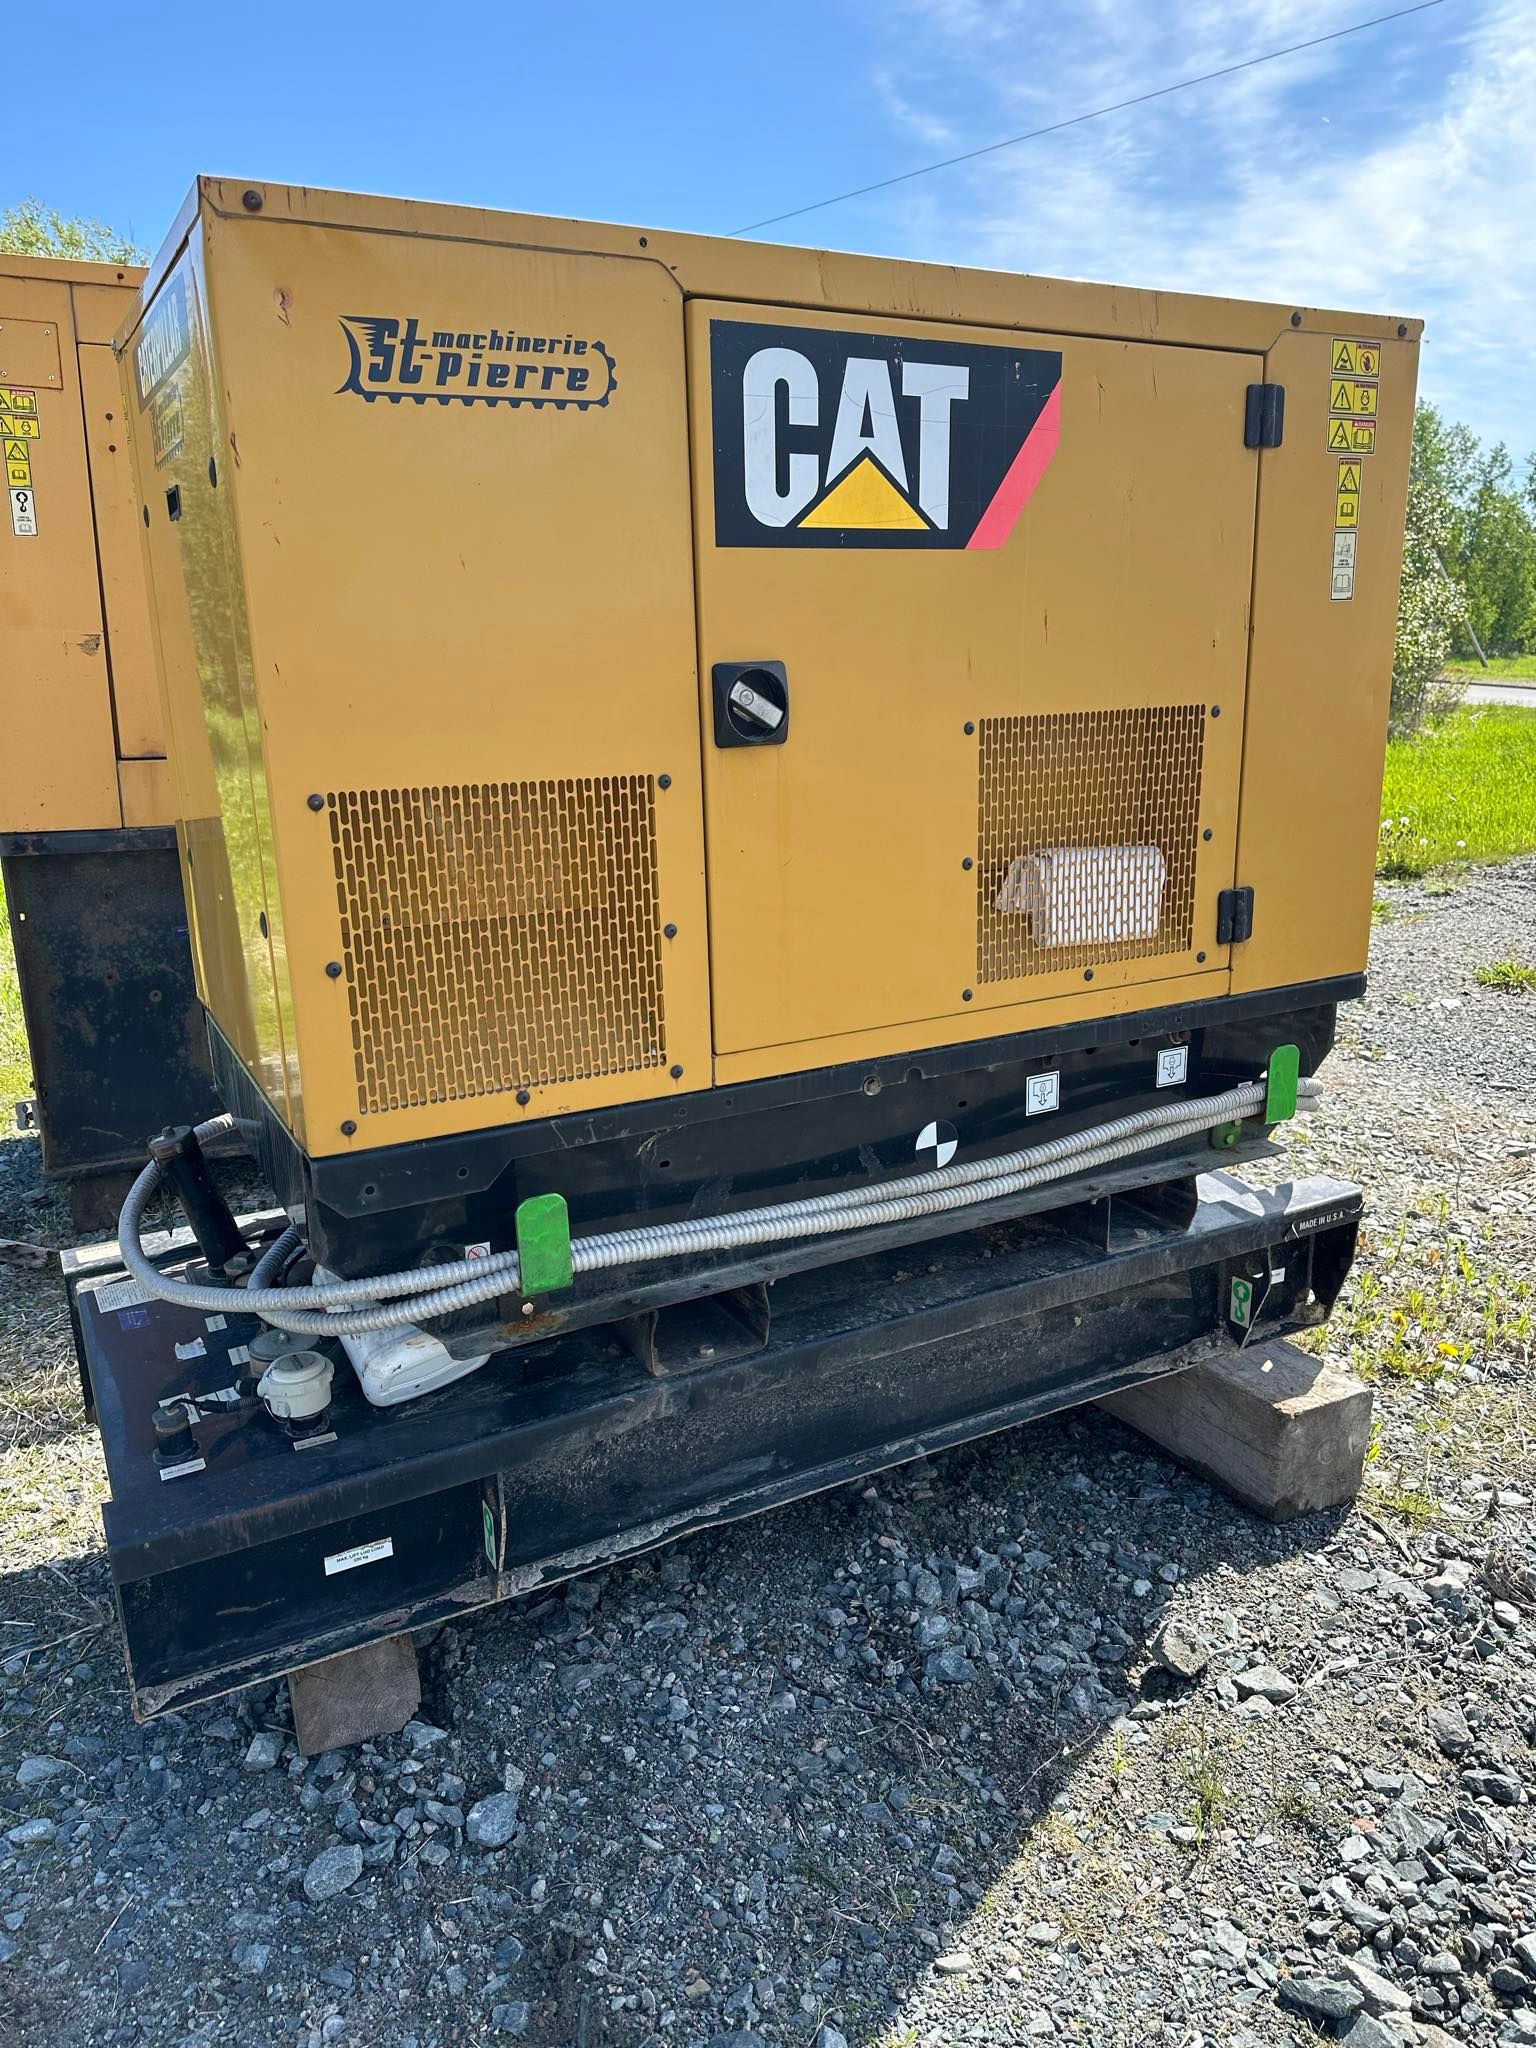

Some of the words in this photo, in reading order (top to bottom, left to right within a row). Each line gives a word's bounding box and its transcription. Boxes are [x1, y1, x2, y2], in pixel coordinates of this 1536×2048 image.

[432, 329, 588, 356] machinerie
[742, 347, 970, 530] CAT
[1299, 1218, 1318, 1231] MADE
[1318, 1216, 1326, 1226] IN
